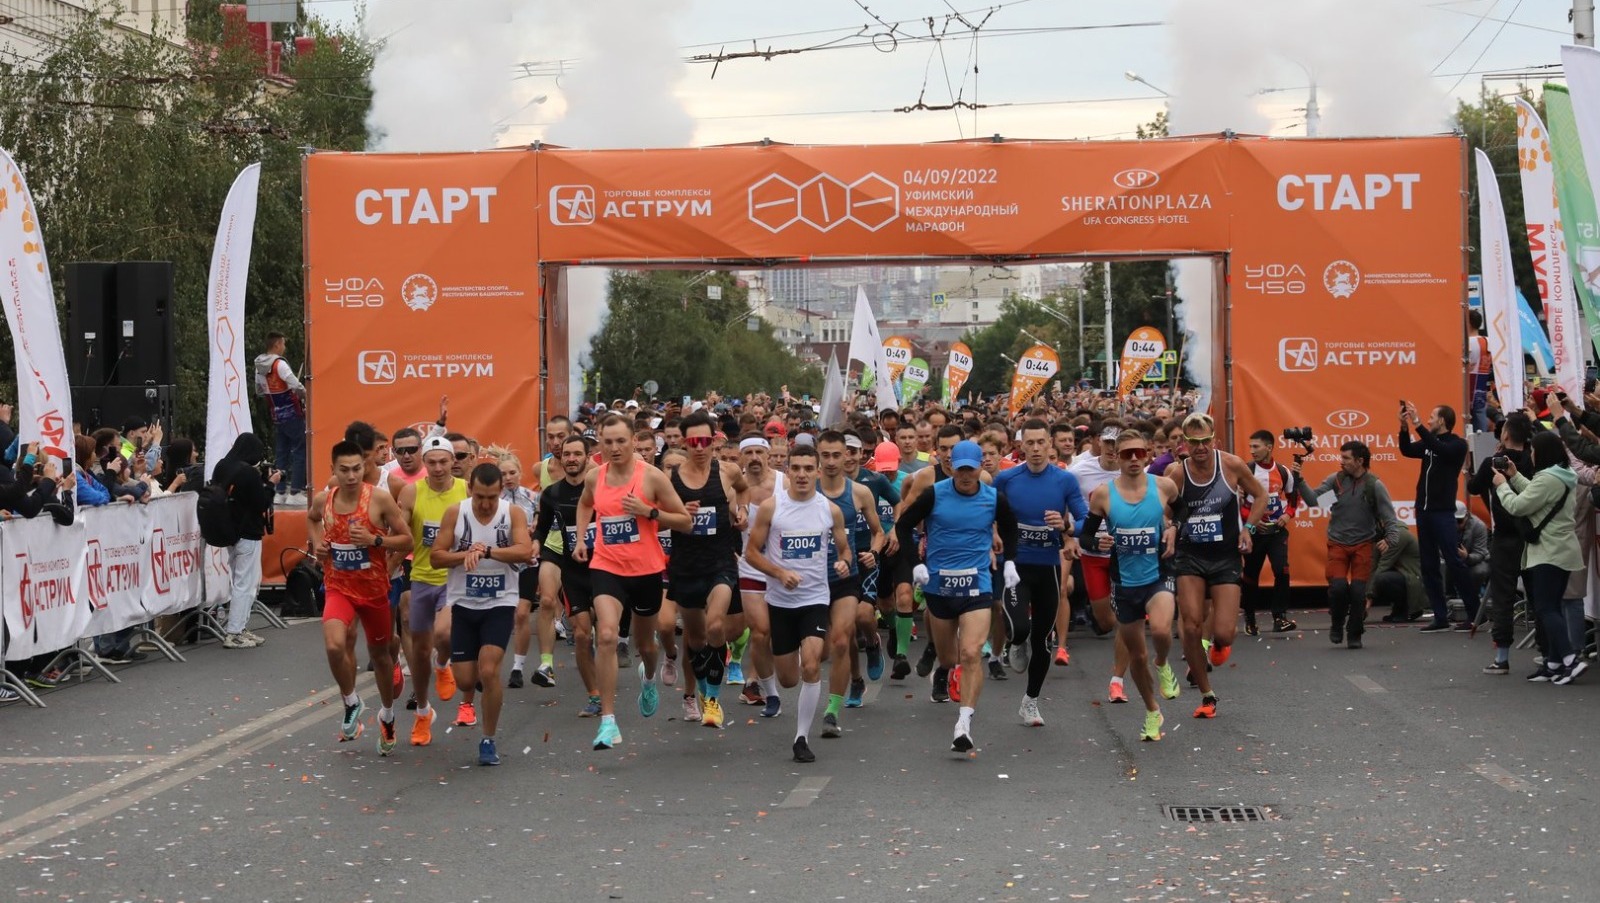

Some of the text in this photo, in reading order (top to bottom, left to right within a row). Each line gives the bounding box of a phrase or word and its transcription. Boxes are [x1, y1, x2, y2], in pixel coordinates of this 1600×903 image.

[903, 168, 998, 185] 04/09/2022
[1126, 171, 1147, 187] SP
[655, 189, 711, 197] КОМПЛЕКСЫ
[905, 189, 974, 201] УФИМСКИЙ
[1277, 173, 1421, 211] СТАРТ
[355, 186, 498, 225] СТАРТ
[603, 199, 712, 218] АСТРУМ
[1061, 194, 1212, 211] SHERATONPLAZA
[905, 203, 1019, 217] МЕЖДУНАРОДНЫЙ
[1083, 215, 1190, 225] UFA CONGRESS HOTEL
[905, 221, 965, 233] МАРАФОН
[1245, 264, 1306, 277] УФА
[325, 277, 384, 291] УФА
[1245, 280, 1305, 294] 450
[325, 294, 384, 308] 450
[886, 347, 907, 359] 0:49
[1131, 341, 1156, 353] 0:44
[1324, 350, 1416, 366] АСТРУМ
[403, 362, 494, 379] АСТРУМ
[1025, 359, 1049, 372] 0:44
[1125, 362, 1150, 392] GARMIN
[1015, 381, 1043, 410] GARMIN
[1337, 412, 1358, 426] SP
[605, 522, 632, 535] 2878
[1191, 522, 1217, 534] 2043
[1294, 520, 1314, 528] УФА
[1021, 530, 1049, 541] 3428
[1121, 535, 1150, 546] 3173
[661, 538, 672, 548] 32
[787, 537, 816, 549] 2004
[335, 550, 363, 562] 2703
[471, 576, 500, 588] 2935
[944, 576, 973, 588] 2909
